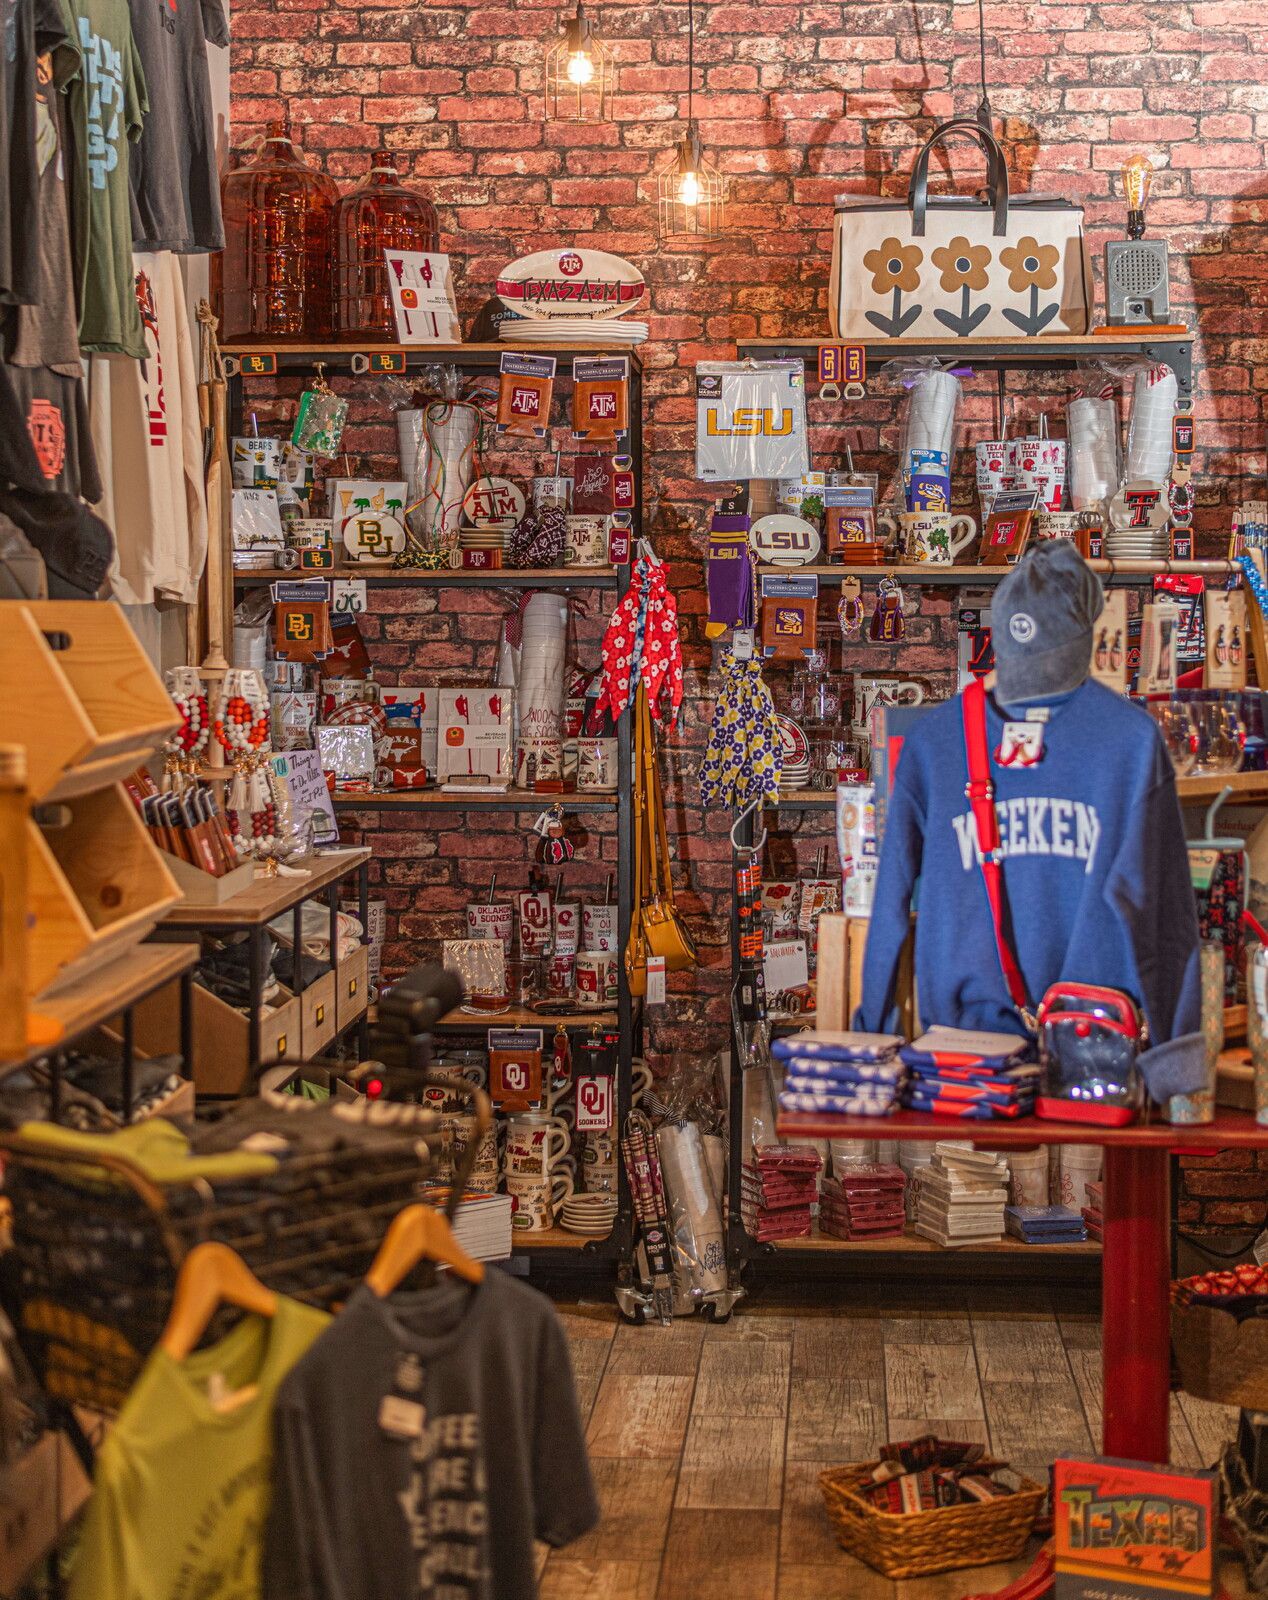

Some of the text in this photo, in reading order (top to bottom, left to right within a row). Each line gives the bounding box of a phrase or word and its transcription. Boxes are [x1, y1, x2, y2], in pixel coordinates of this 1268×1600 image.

[517, 277, 573, 304] TEXAS
[251, 356, 265, 372] BU
[380, 355, 394, 370] BU
[824, 349, 835, 379] LSU
[850, 349, 860, 379] LSU
[706, 408, 793, 436] LSU
[357, 520, 393, 558] BU
[840, 533, 864, 542] LSU
[913, 522, 932, 530] LSU
[709, 548, 738, 559] LSU
[755, 531, 811, 550] LSU
[287, 613, 311, 640] BU
[776, 623, 803, 635] LSU
[884, 610, 894, 639] LSU
[289, 754, 315, 770] Things
[523, 898, 549, 929] OU
[599, 920, 611, 928] OU
[506, 1063, 525, 1090] OU
[581, 1082, 605, 1114] OU
[578, 1118, 606, 1126] SOONERS
[1061, 1489, 1200, 1553] TEXAS
